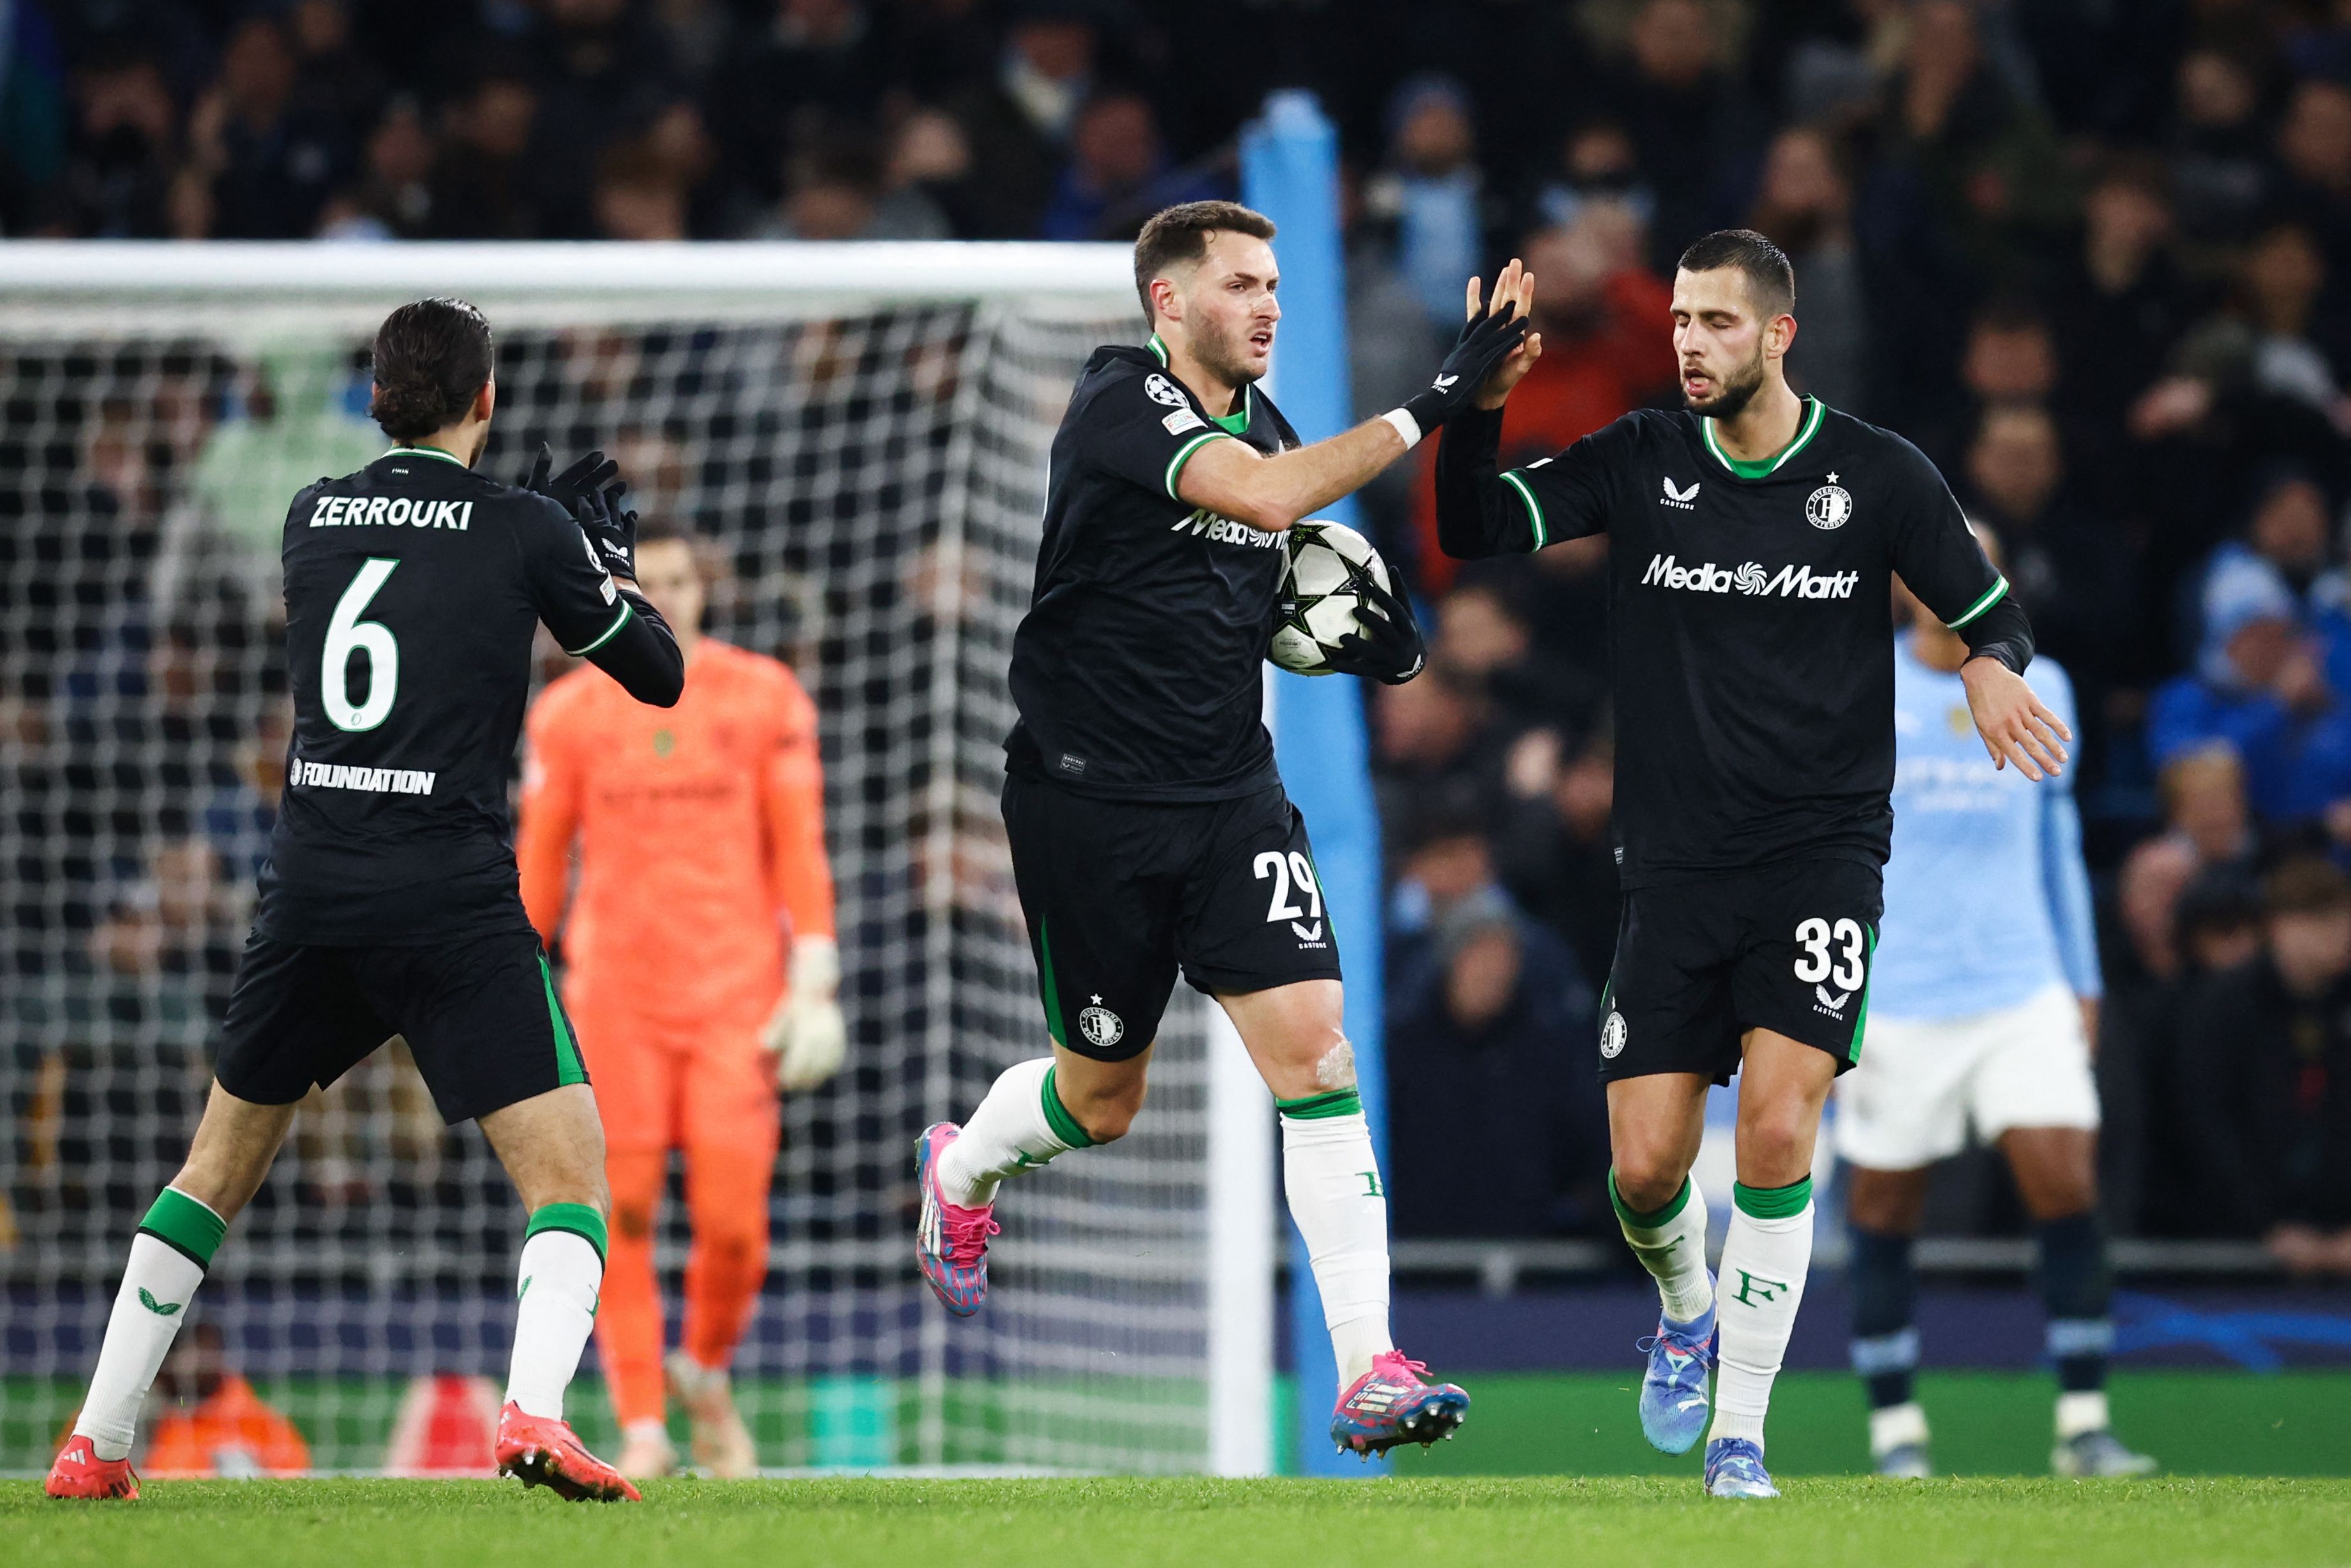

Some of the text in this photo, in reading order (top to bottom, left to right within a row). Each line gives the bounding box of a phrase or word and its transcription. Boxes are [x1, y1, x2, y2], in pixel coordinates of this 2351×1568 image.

[1660, 498, 1694, 511] CASTORE
[1810, 488, 1849, 502] FEYENOORD
[309, 496, 474, 531] ZERROUKI
[1809, 512, 1848, 528] ROTTERDAM
[1641, 554, 1859, 599] Media Markt
[321, 556, 400, 732] 6
[302, 762, 437, 795] FOUNDATION
[1253, 851, 1321, 923] 29
[1794, 917, 1864, 991] 33
[1812, 1004, 1844, 1021] CASTORE
[1731, 1268, 1788, 1308] F
